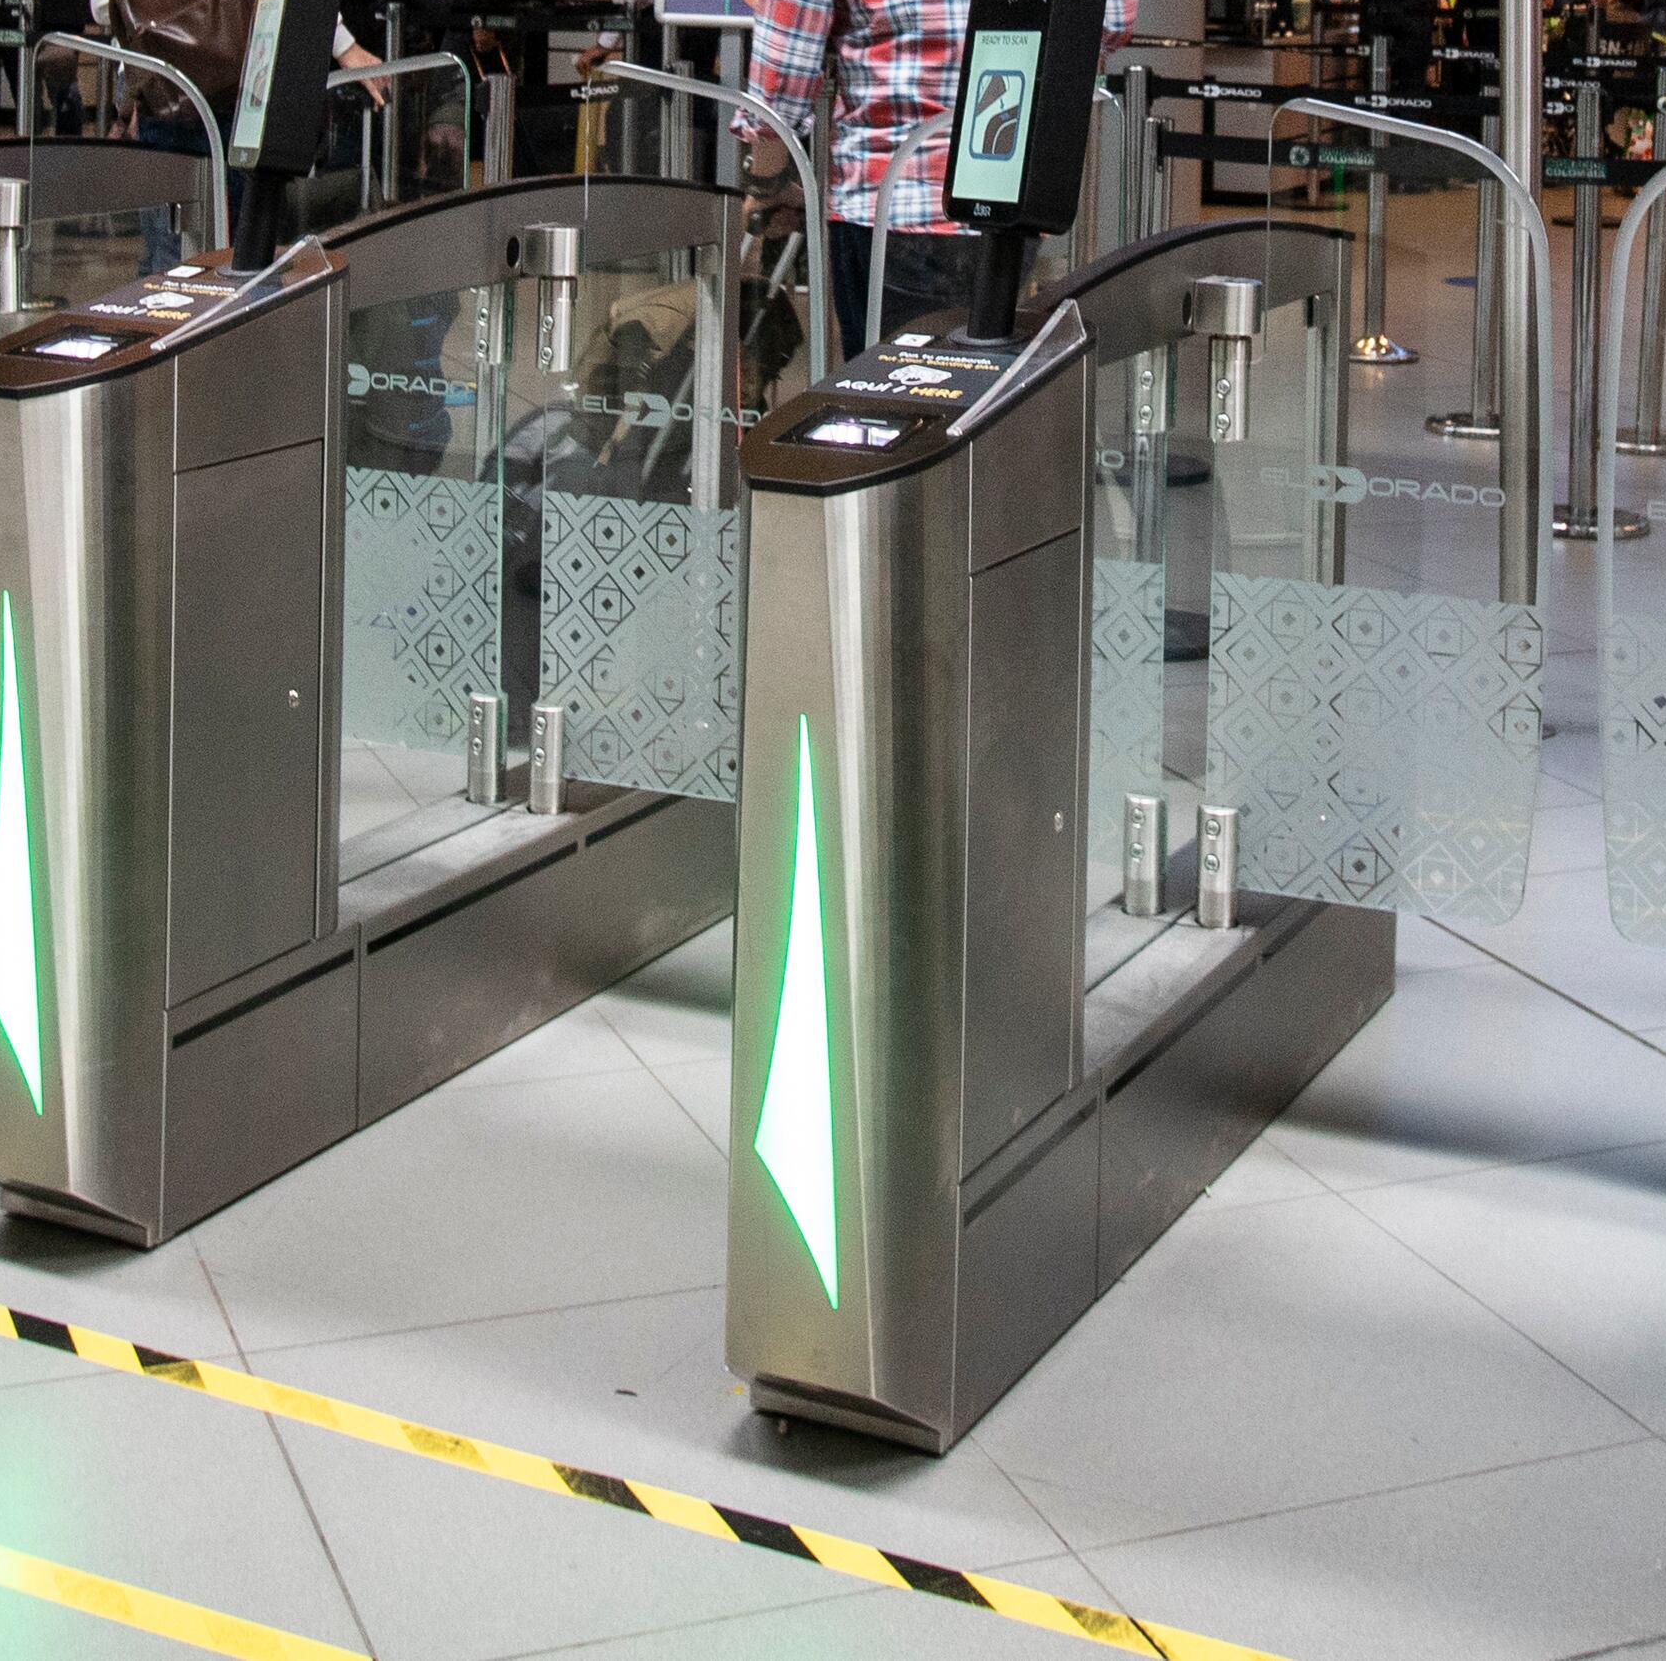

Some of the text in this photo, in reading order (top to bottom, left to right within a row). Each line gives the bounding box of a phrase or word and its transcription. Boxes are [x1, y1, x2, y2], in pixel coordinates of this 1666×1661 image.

[1188, 84, 1261, 98] EL DORADO
[1370, 95, 1432, 108] DORADO
[1318, 153, 1374, 166] COLOMBIA
[909, 386, 964, 399] HERE
[584, 395, 624, 415] EL
[1306, 466, 1506, 507] DORADO
